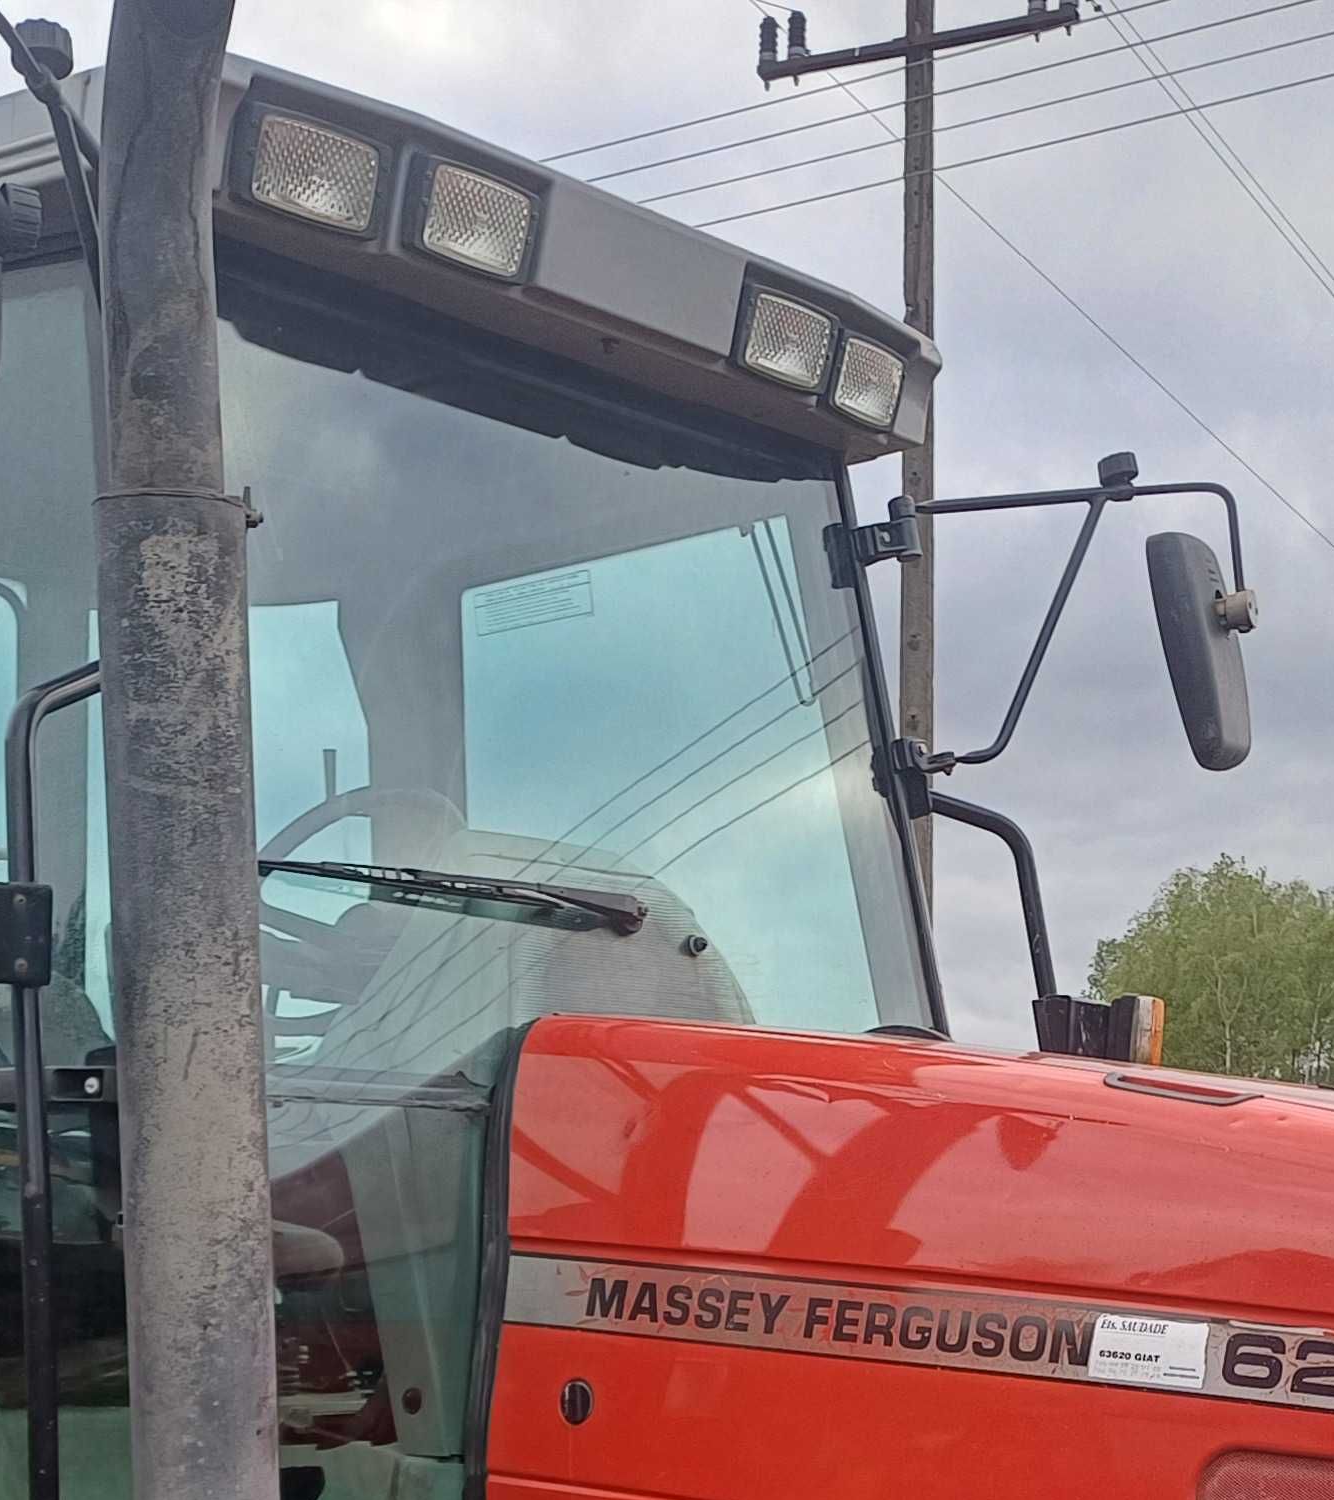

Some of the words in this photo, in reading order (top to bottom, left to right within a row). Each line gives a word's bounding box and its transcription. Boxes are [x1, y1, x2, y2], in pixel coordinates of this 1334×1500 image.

[584, 1277, 792, 1335] MASSEY
[803, 1296, 1093, 1367] FERGUSON
[1119, 1320, 1169, 1336] SAUDADE
[1099, 1349, 1131, 1361] 63620
